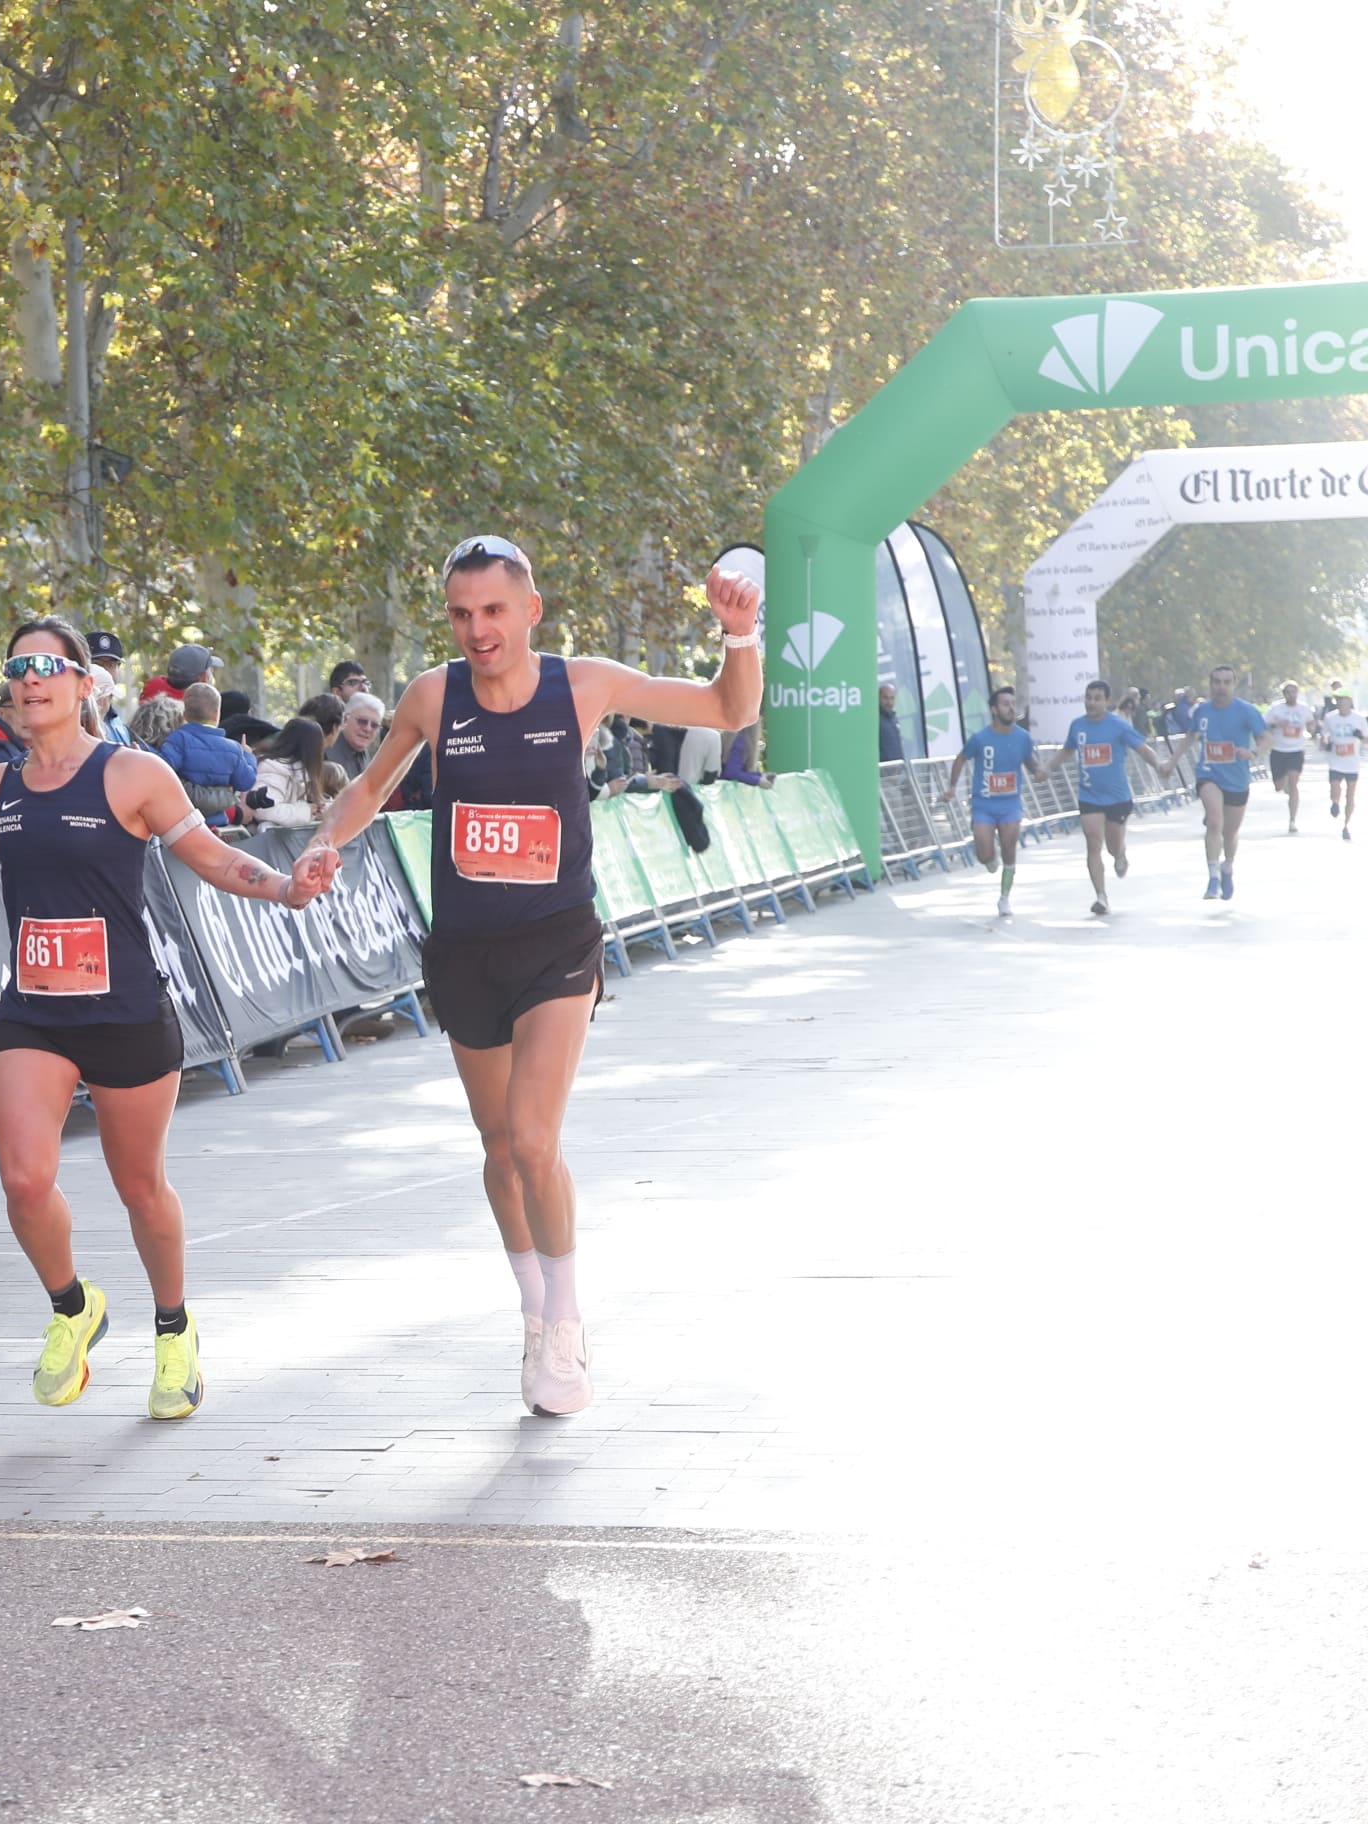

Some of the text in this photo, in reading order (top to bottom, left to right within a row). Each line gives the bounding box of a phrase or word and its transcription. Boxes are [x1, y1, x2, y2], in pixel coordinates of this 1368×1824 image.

[1179, 469, 1220, 504] El
[1228, 467, 1312, 503] Norte
[1319, 467, 1352, 499] de
[769, 681, 862, 713] Unicaja
[446, 735, 482, 746] RENAULT
[524, 730, 566, 740] DEPARTAMENTO
[533, 737, 559, 745] MONTAJE
[445, 744, 485, 756] PALENCIA
[61, 815, 106, 825] DEPARTAMENTO
[70, 821, 96, 829] MONTAJE
[466, 820, 520, 854] 859
[26, 934, 63, 967] 861
